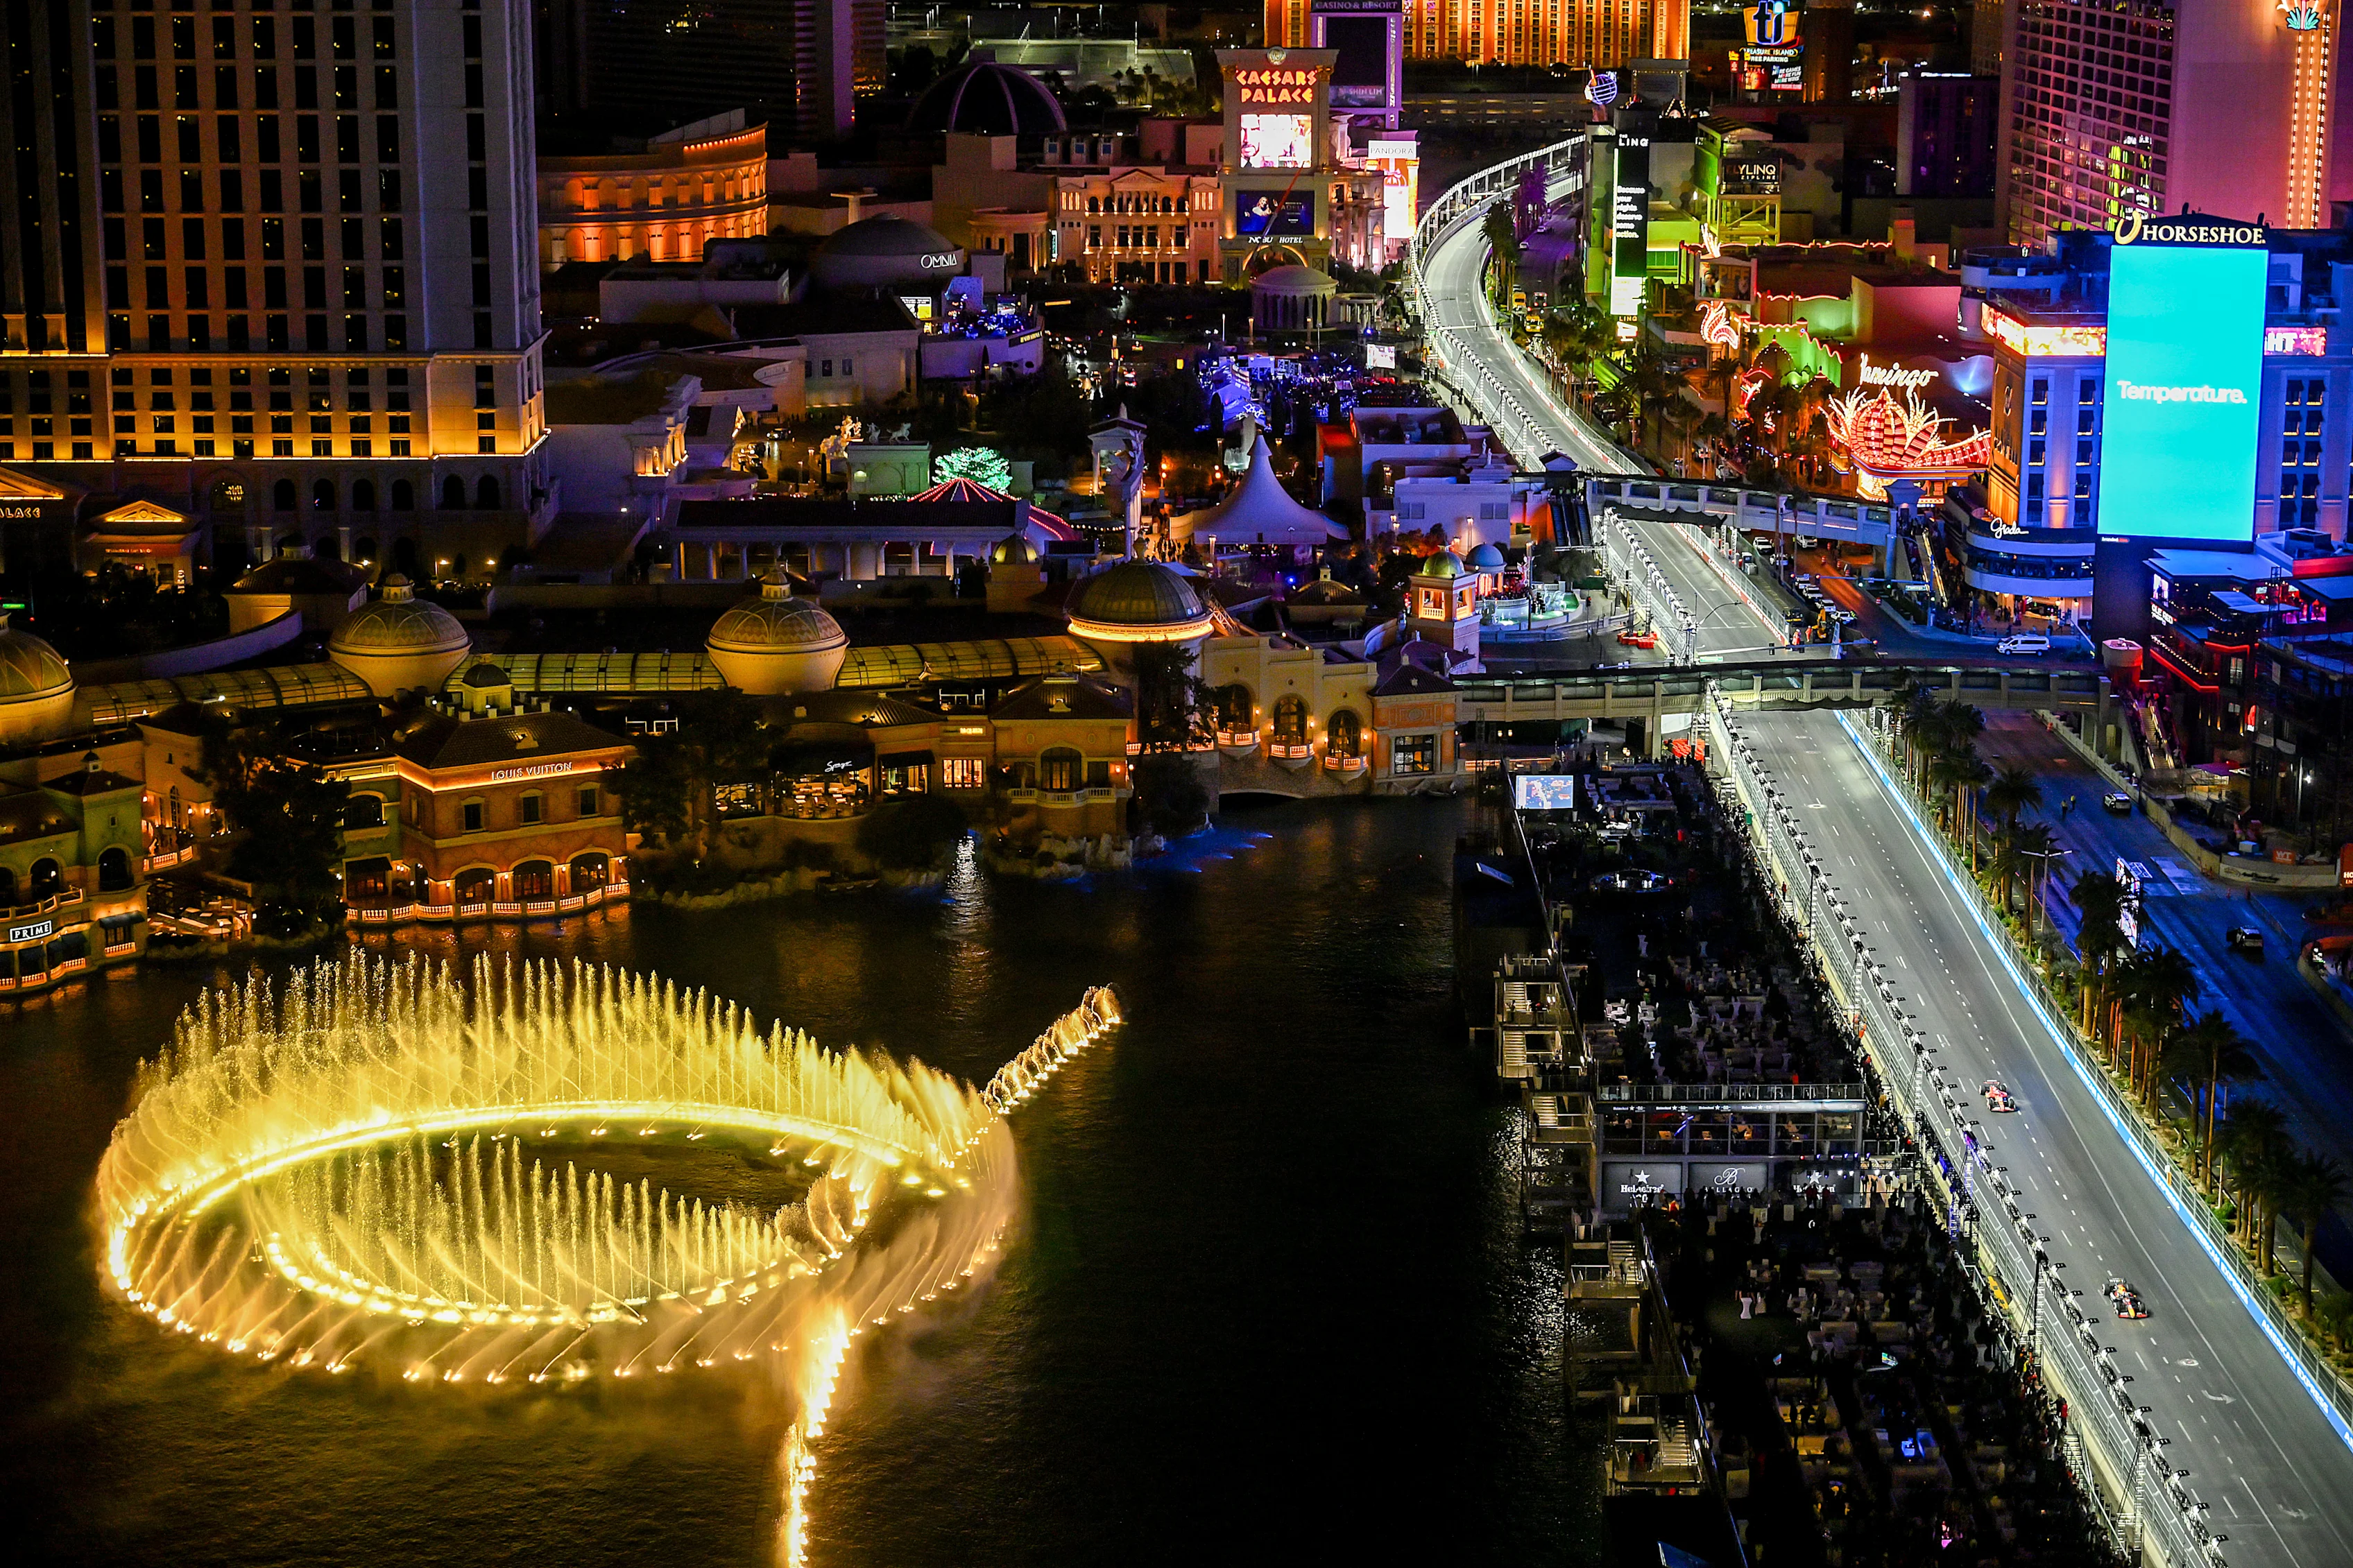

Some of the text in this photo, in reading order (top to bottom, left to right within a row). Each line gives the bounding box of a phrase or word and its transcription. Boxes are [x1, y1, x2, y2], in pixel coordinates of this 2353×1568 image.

[1316, 1, 1398, 10] CASINO & RESORT
[1236, 70, 1317, 86] CAESARS
[1241, 87, 1313, 103] PALACE
[1618, 138, 1649, 147] LINQ
[921, 254, 957, 269] OMNIA
[2116, 380, 2248, 404] Temperature.
[1990, 517, 2029, 539] Giada
[491, 761, 572, 781] LOUIS VUITTON
[825, 760, 853, 773] Spago
[15, 924, 49, 939] PRIME
[2189, 1221, 2249, 1305] AMERICAN EXPRESS
[2261, 1319, 2329, 1414] AMERICAN EXPRESS
